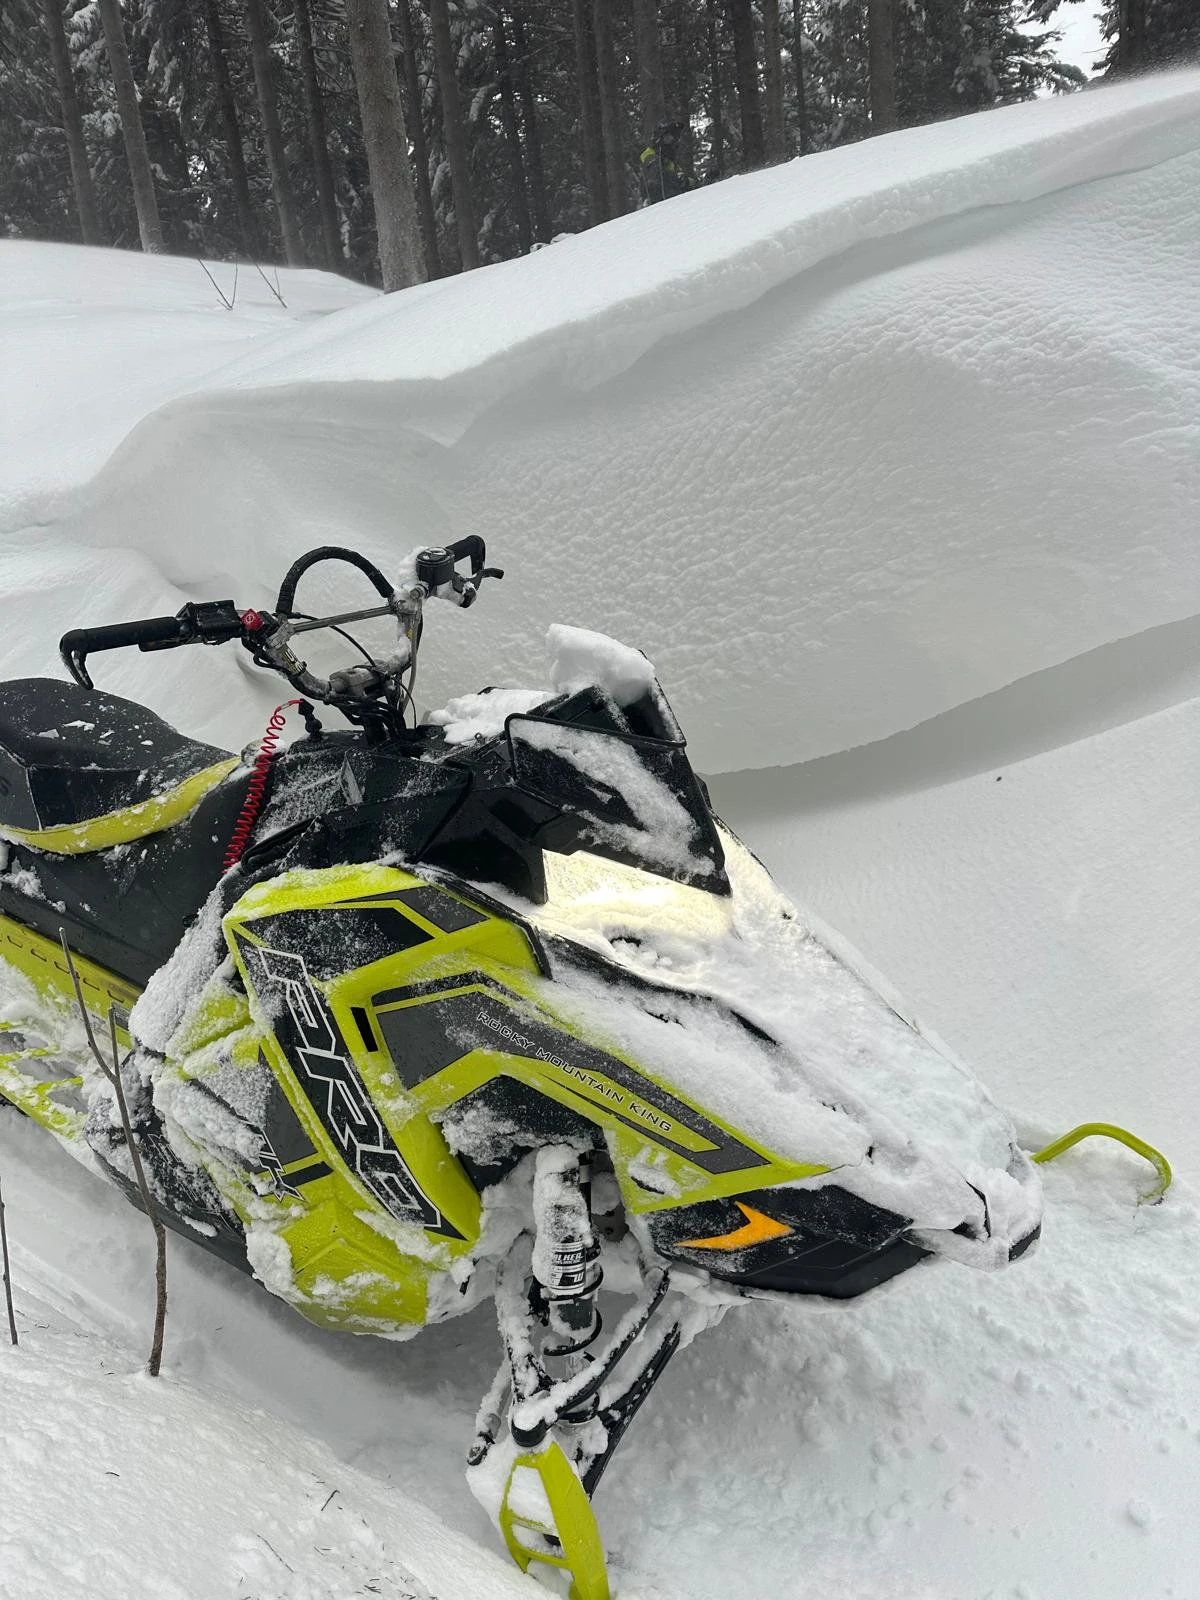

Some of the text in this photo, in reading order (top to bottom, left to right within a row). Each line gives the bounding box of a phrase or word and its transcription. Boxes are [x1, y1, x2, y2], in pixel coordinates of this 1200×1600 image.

[258, 946, 441, 1228] PRO
[476, 1012, 673, 1133] ROCKY MOUNTAIN KING
